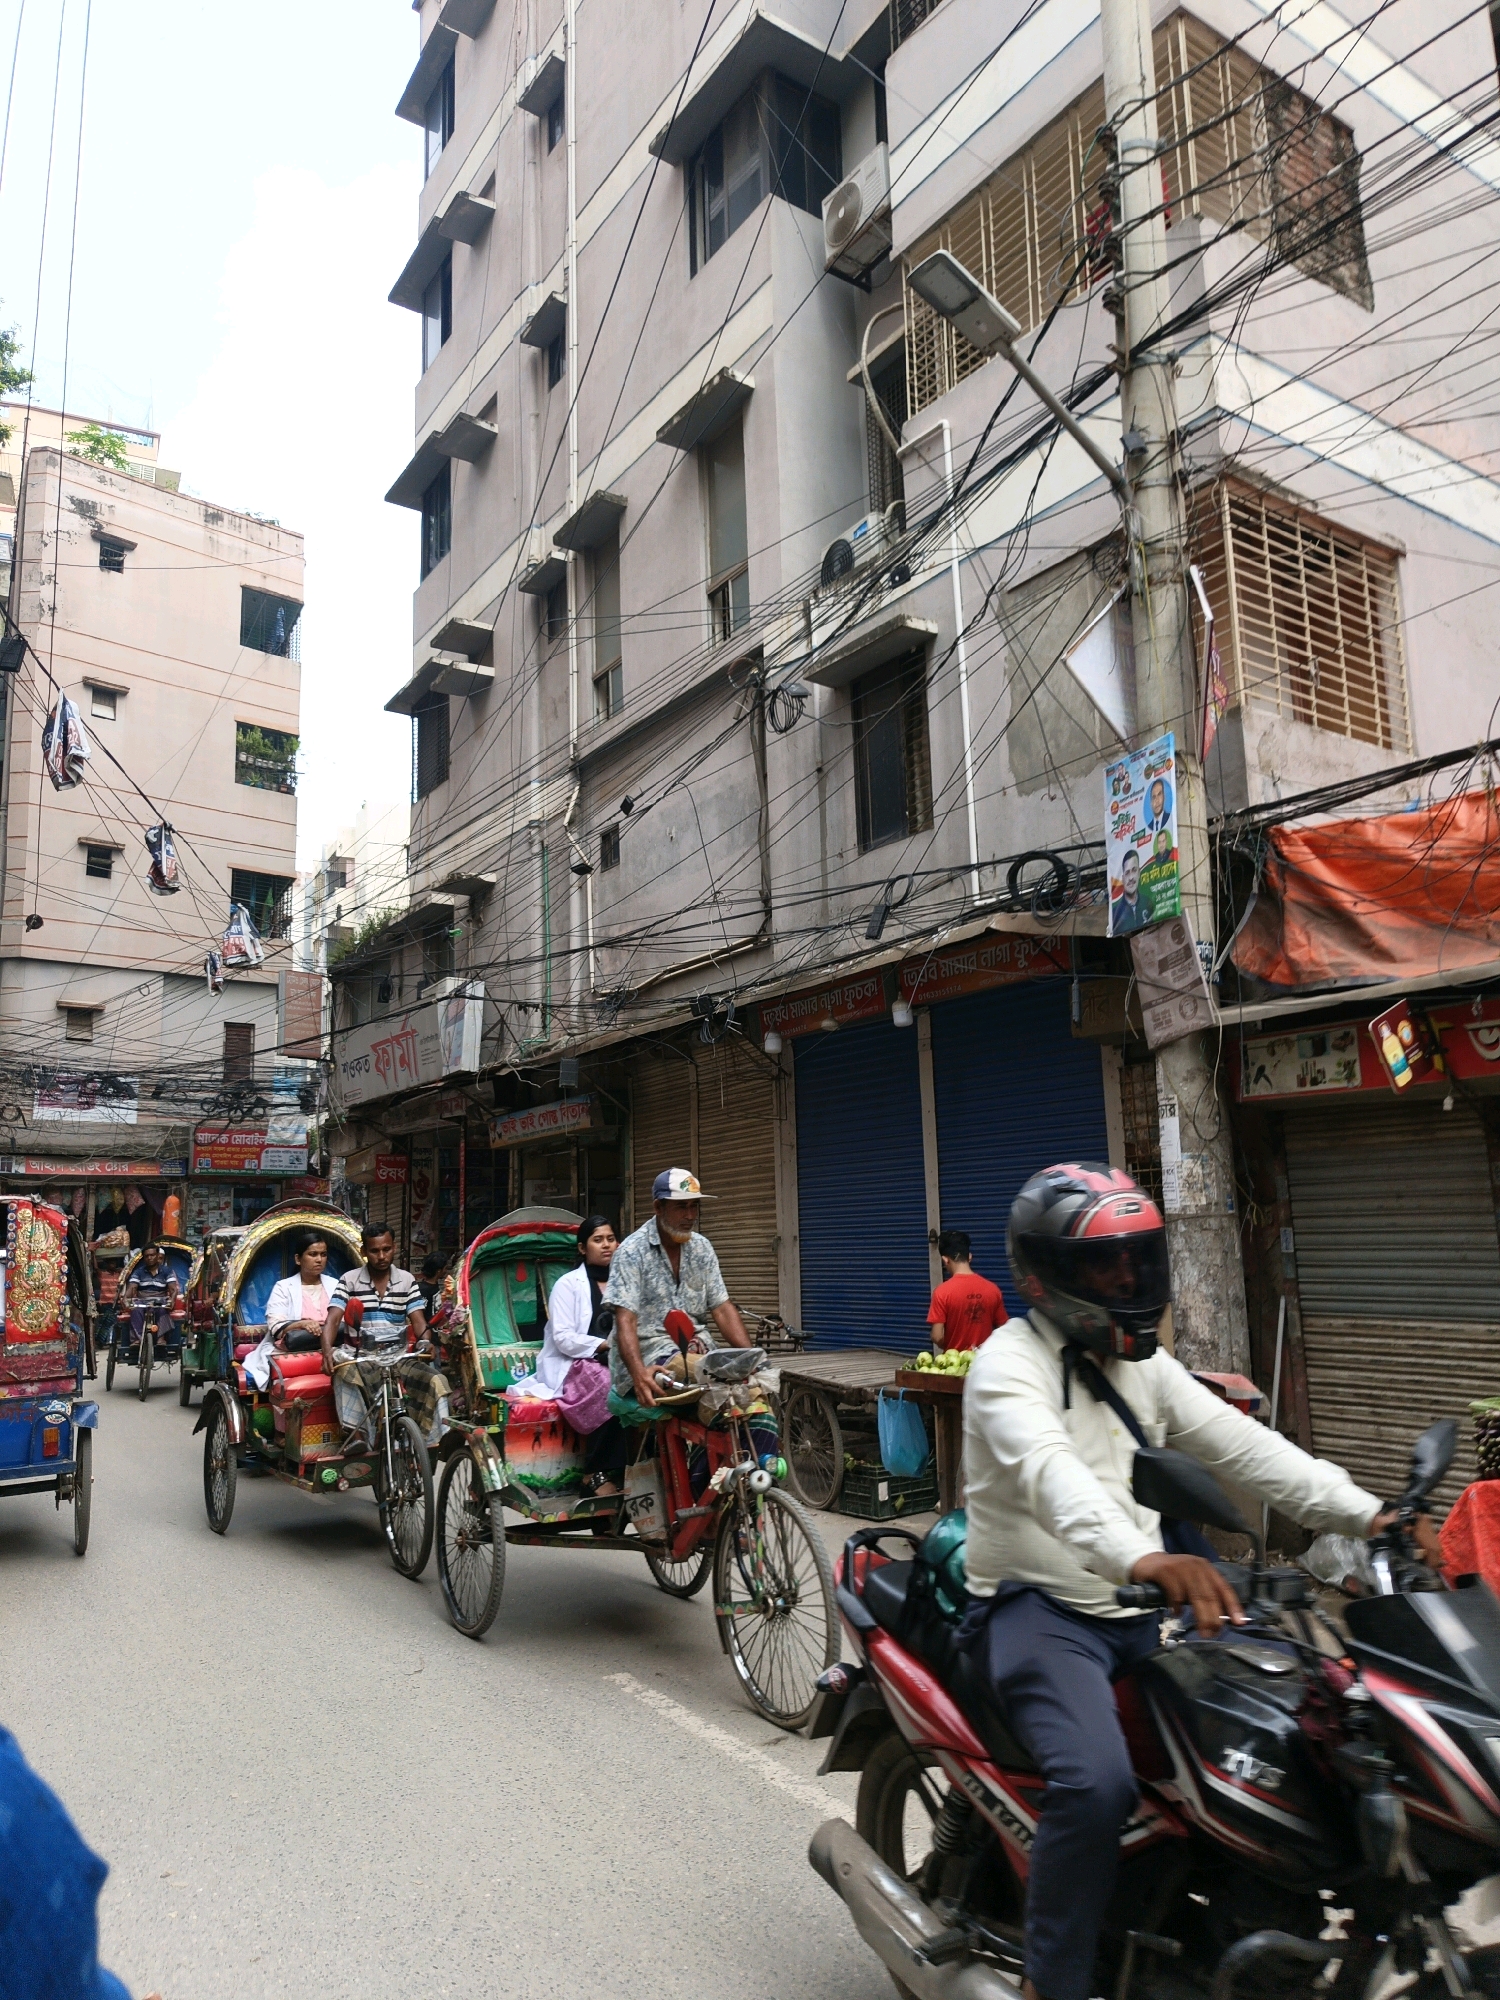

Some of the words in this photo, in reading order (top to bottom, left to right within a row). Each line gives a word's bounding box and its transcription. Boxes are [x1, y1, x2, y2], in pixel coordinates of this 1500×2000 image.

[980, 942, 1011, 967] নাগা
[843, 977, 879, 1011] ফুচকা
[341, 1054, 371, 1081] শওকত
[370, 1013, 420, 1089] ফার্মা
[501, 1118, 518, 1136] ভাই
[519, 1114, 536, 1132] ভাই
[232, 1132, 267, 1146] মোবাইল
[378, 1162, 407, 1181] ঔষধ
